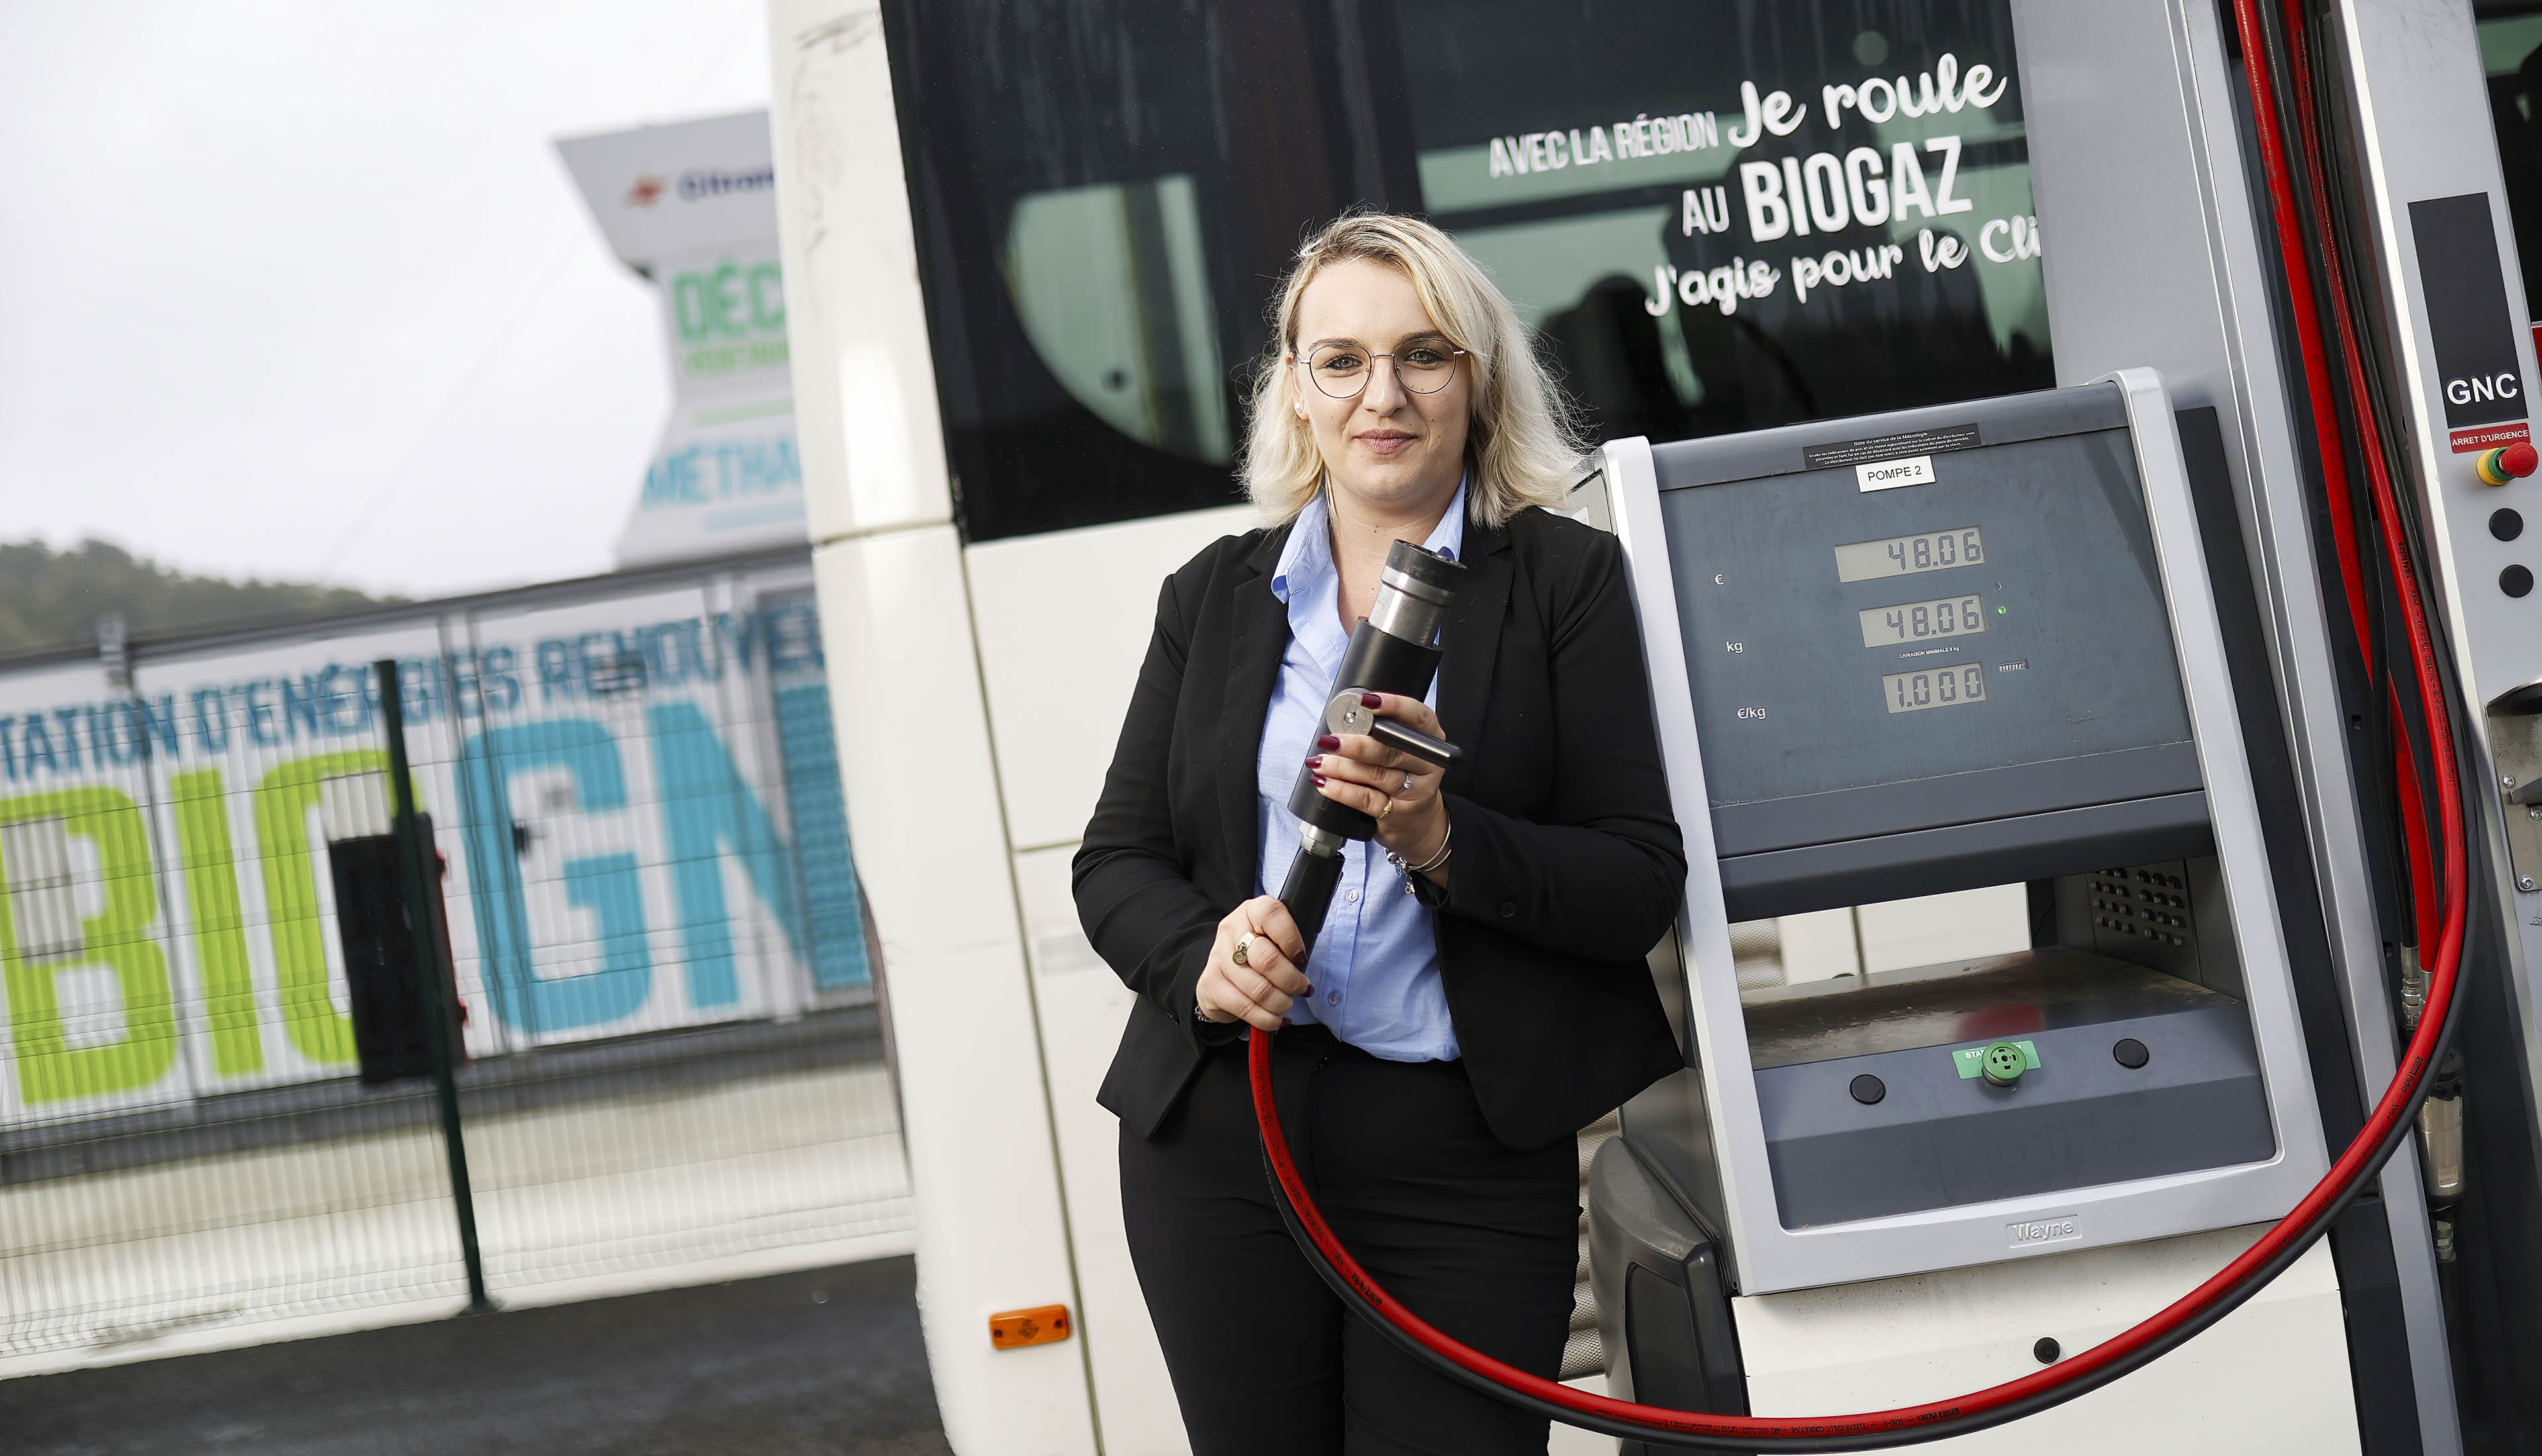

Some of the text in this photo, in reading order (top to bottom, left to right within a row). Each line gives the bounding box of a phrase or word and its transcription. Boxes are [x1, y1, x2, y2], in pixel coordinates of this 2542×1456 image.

[1489, 52, 2008, 178] AVEC LA RÉGION Je roule
[1683, 135, 1973, 243] AU BIOGAZ
[1644, 257, 1781, 317] J'agis
[1792, 244, 1903, 304] pour
[1920, 228, 1969, 273] le
[2447, 373, 2518, 405] GNC
[2452, 429, 2529, 446] ARRET D'URGENCE
[1867, 465, 1922, 482] POMPE 2
[1888, 531, 1981, 570] 48.06
[1715, 574, 1724, 585] €
[1887, 599, 1979, 639] 48.06
[1726, 641, 1743, 653] kg
[1898, 668, 1982, 707] 1.000
[1737, 707, 1766, 719] €/kg
[2011, 1222, 2075, 1242] Wayne
